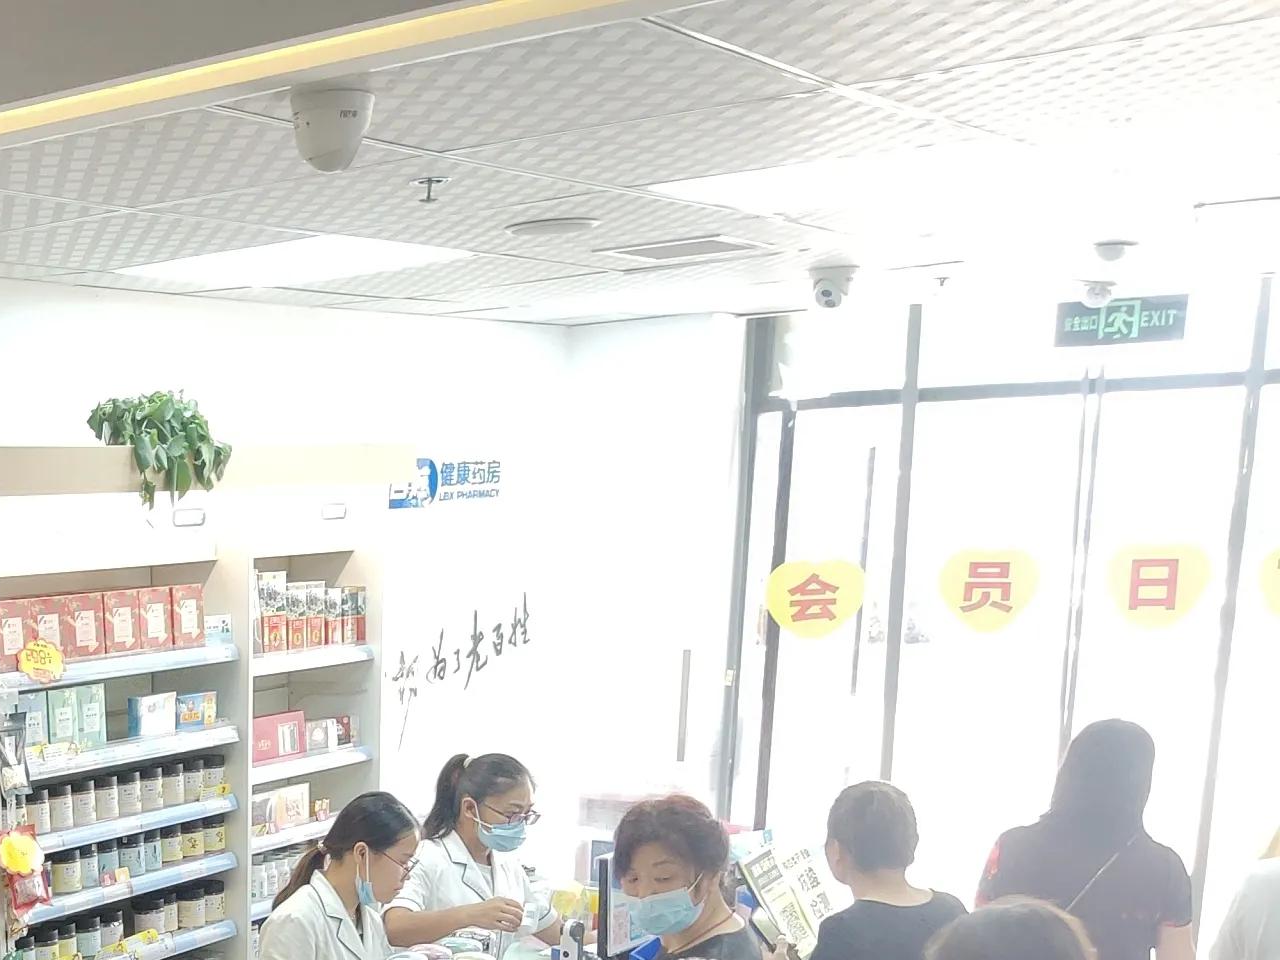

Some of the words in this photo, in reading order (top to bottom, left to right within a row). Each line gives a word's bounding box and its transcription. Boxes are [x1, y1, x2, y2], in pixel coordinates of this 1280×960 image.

[1140, 309, 1177, 328] EXIT
[440, 460, 501, 487] 健康药房
[439, 492, 455, 502] LBX
[456, 488, 500, 500] PHARMACY
